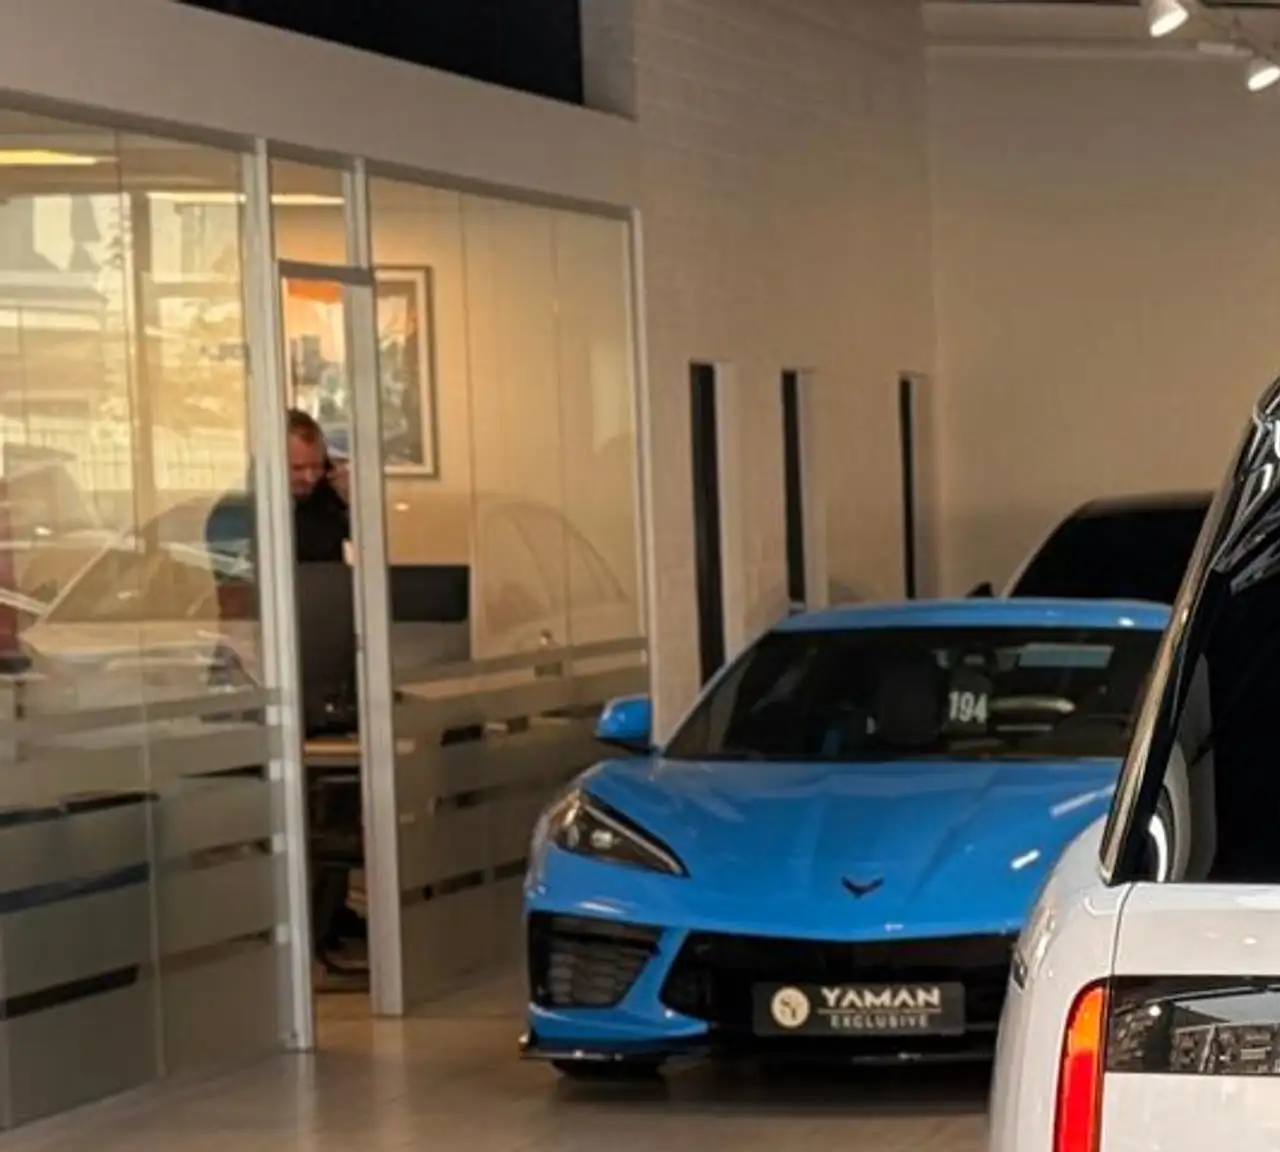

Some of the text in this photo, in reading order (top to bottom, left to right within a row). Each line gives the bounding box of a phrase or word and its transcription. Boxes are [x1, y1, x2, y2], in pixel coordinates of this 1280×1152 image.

[948, 690, 988, 724] 194
[820, 986, 941, 1008] YAMAN
[829, 1014, 929, 1029] EXCLUSIVE
